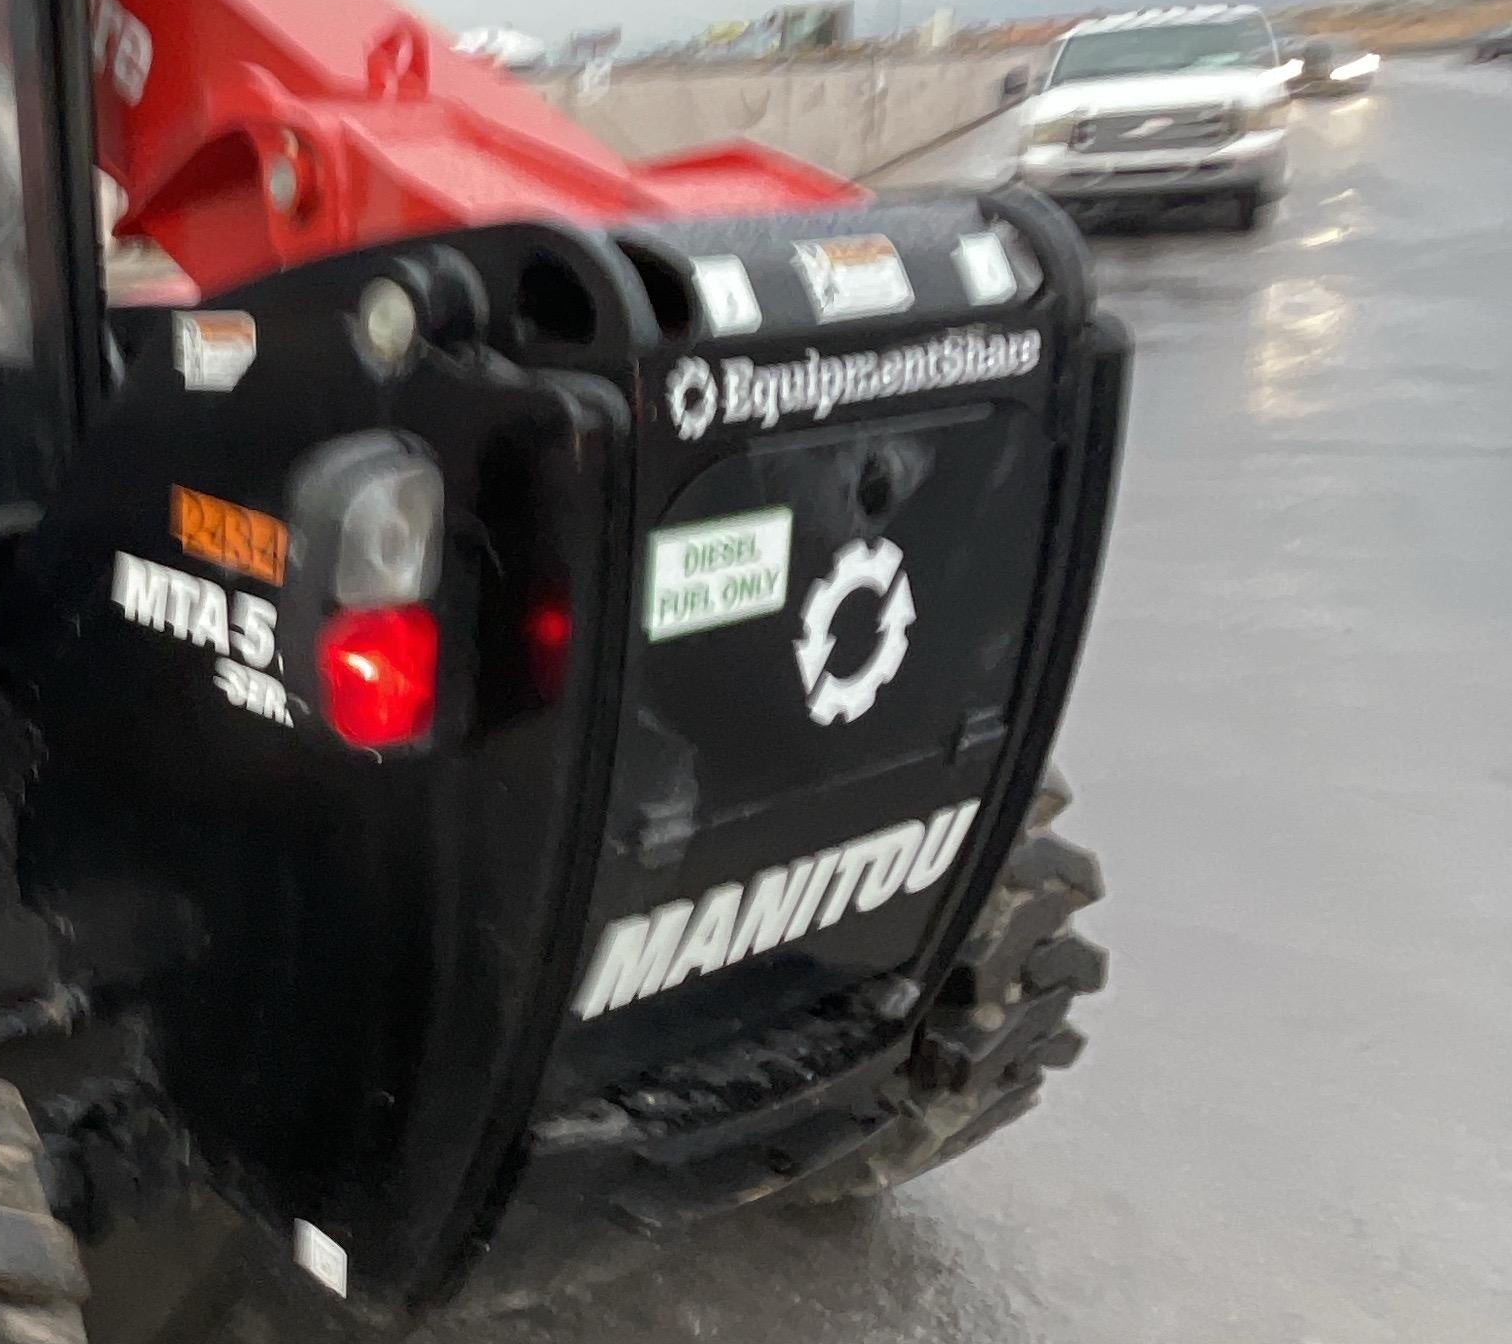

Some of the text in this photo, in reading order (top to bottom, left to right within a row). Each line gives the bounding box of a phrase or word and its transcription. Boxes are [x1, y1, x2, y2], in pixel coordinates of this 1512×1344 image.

[683, 532, 762, 578] DIESEL
[658, 568, 781, 626] FUEL ONLY
[572, 798, 981, 1022] MANITOU
